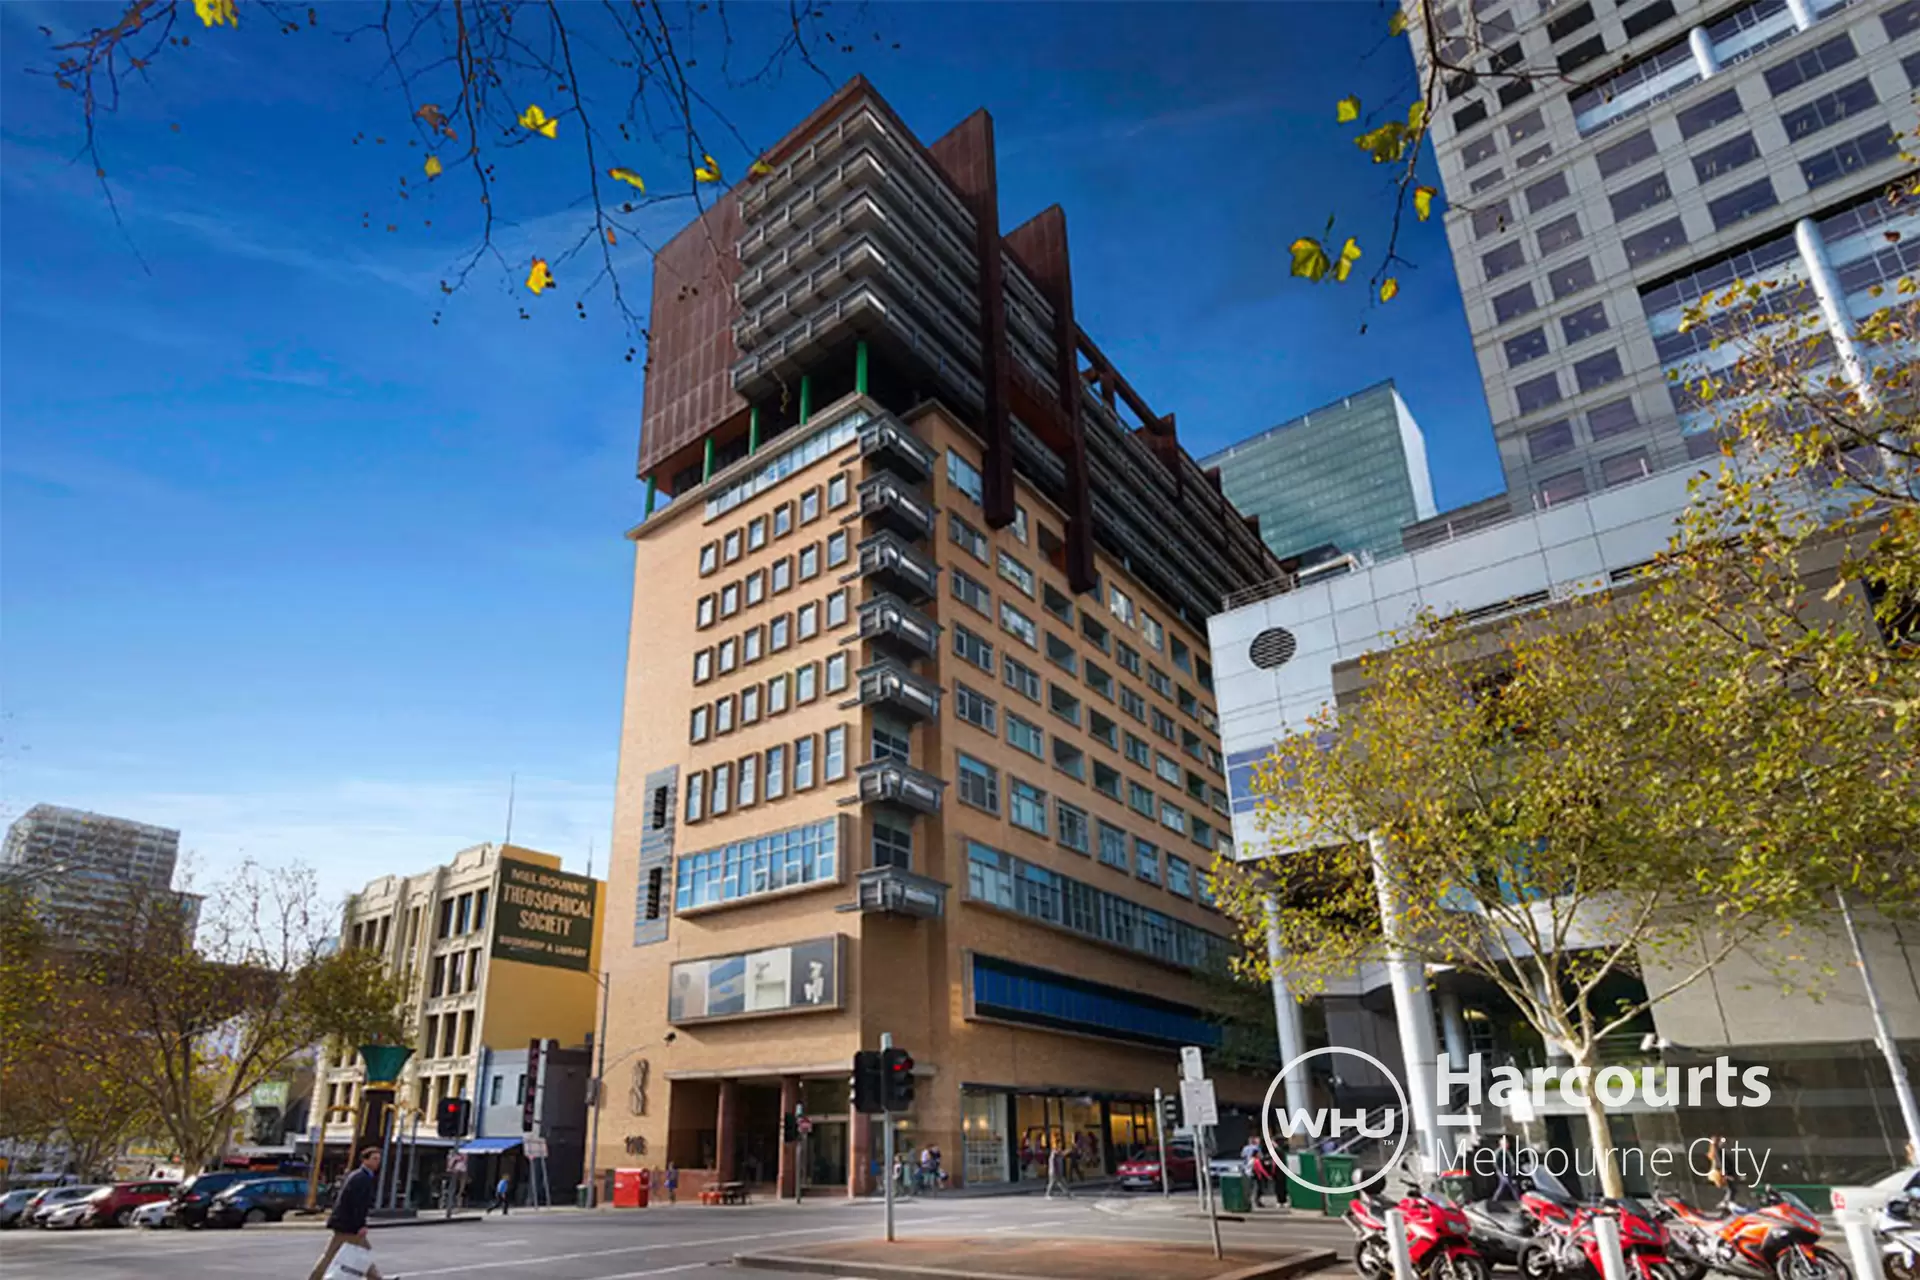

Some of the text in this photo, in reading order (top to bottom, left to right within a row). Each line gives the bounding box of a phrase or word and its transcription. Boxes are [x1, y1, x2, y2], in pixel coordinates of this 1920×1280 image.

[511, 868, 588, 895] MELBOURNE
[503, 883, 591, 918] THEOSOPHICAL
[518, 910, 572, 936] SOCIETY
